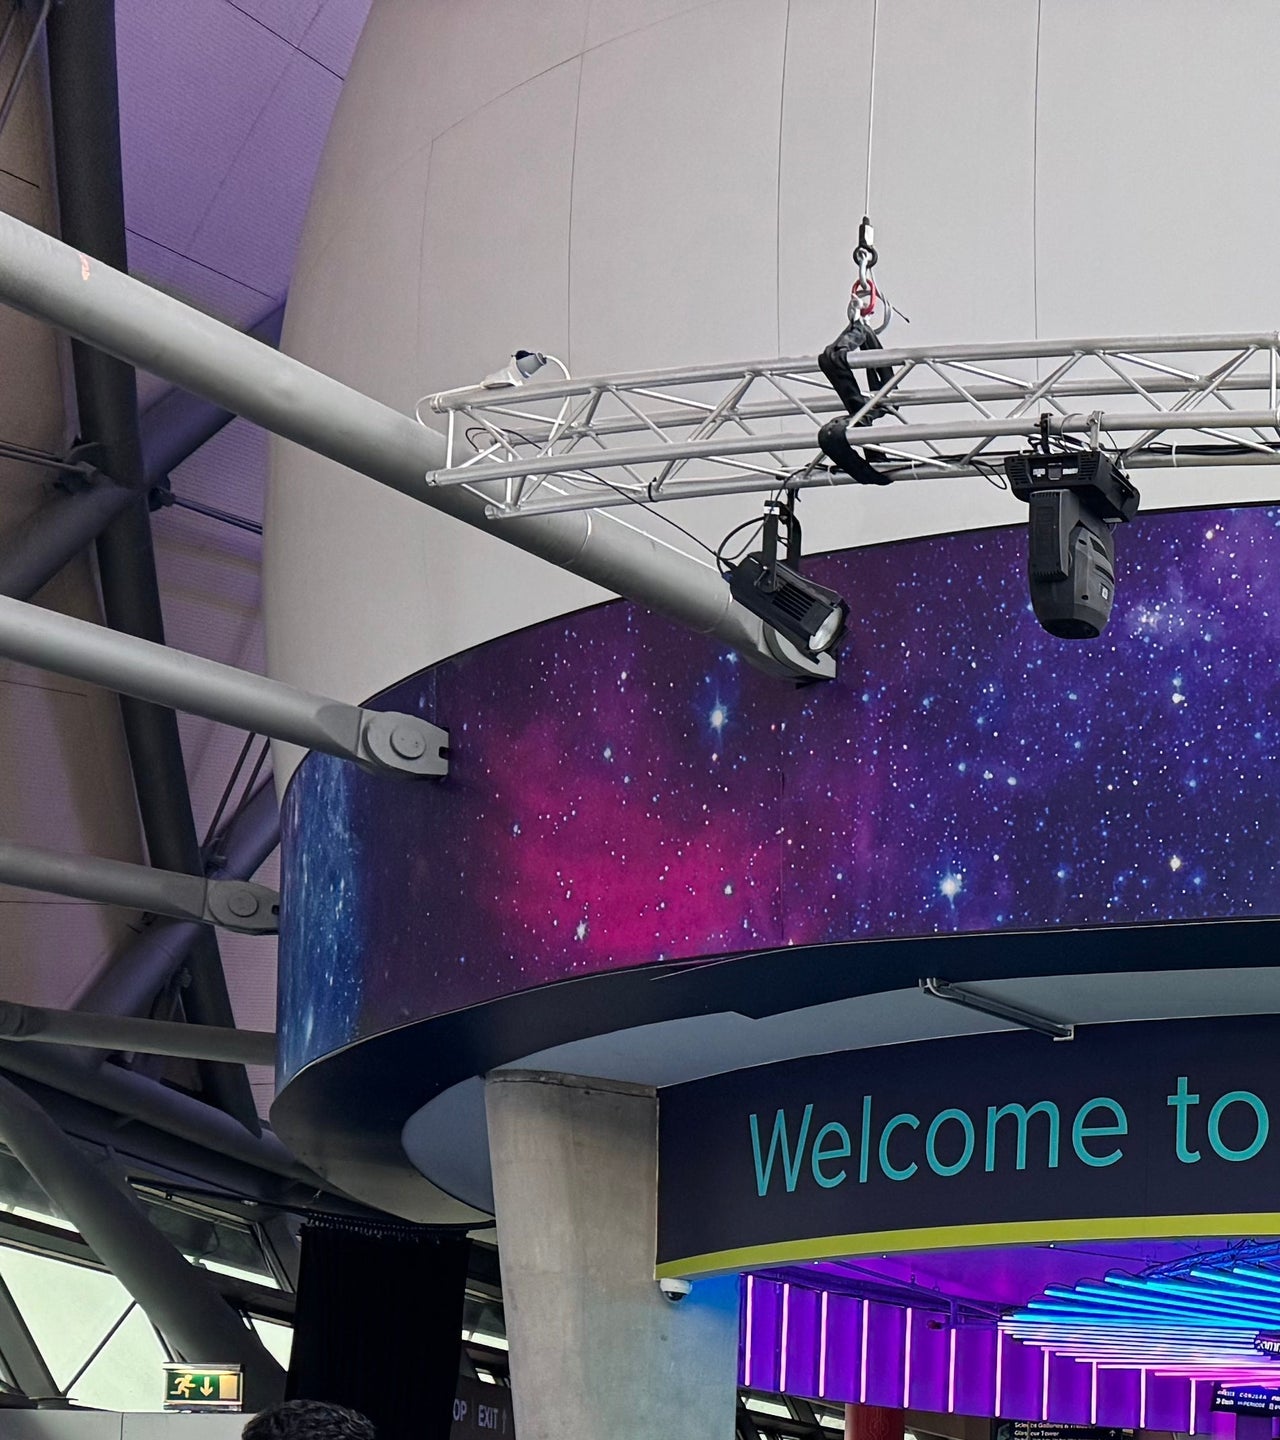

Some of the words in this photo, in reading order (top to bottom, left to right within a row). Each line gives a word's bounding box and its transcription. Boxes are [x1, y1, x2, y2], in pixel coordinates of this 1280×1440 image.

[750, 1096, 1128, 1198] Welcome
[1167, 1077, 1270, 1164] to
[453, 1398, 467, 1421] OP
[477, 1404, 498, 1430] EXIT
